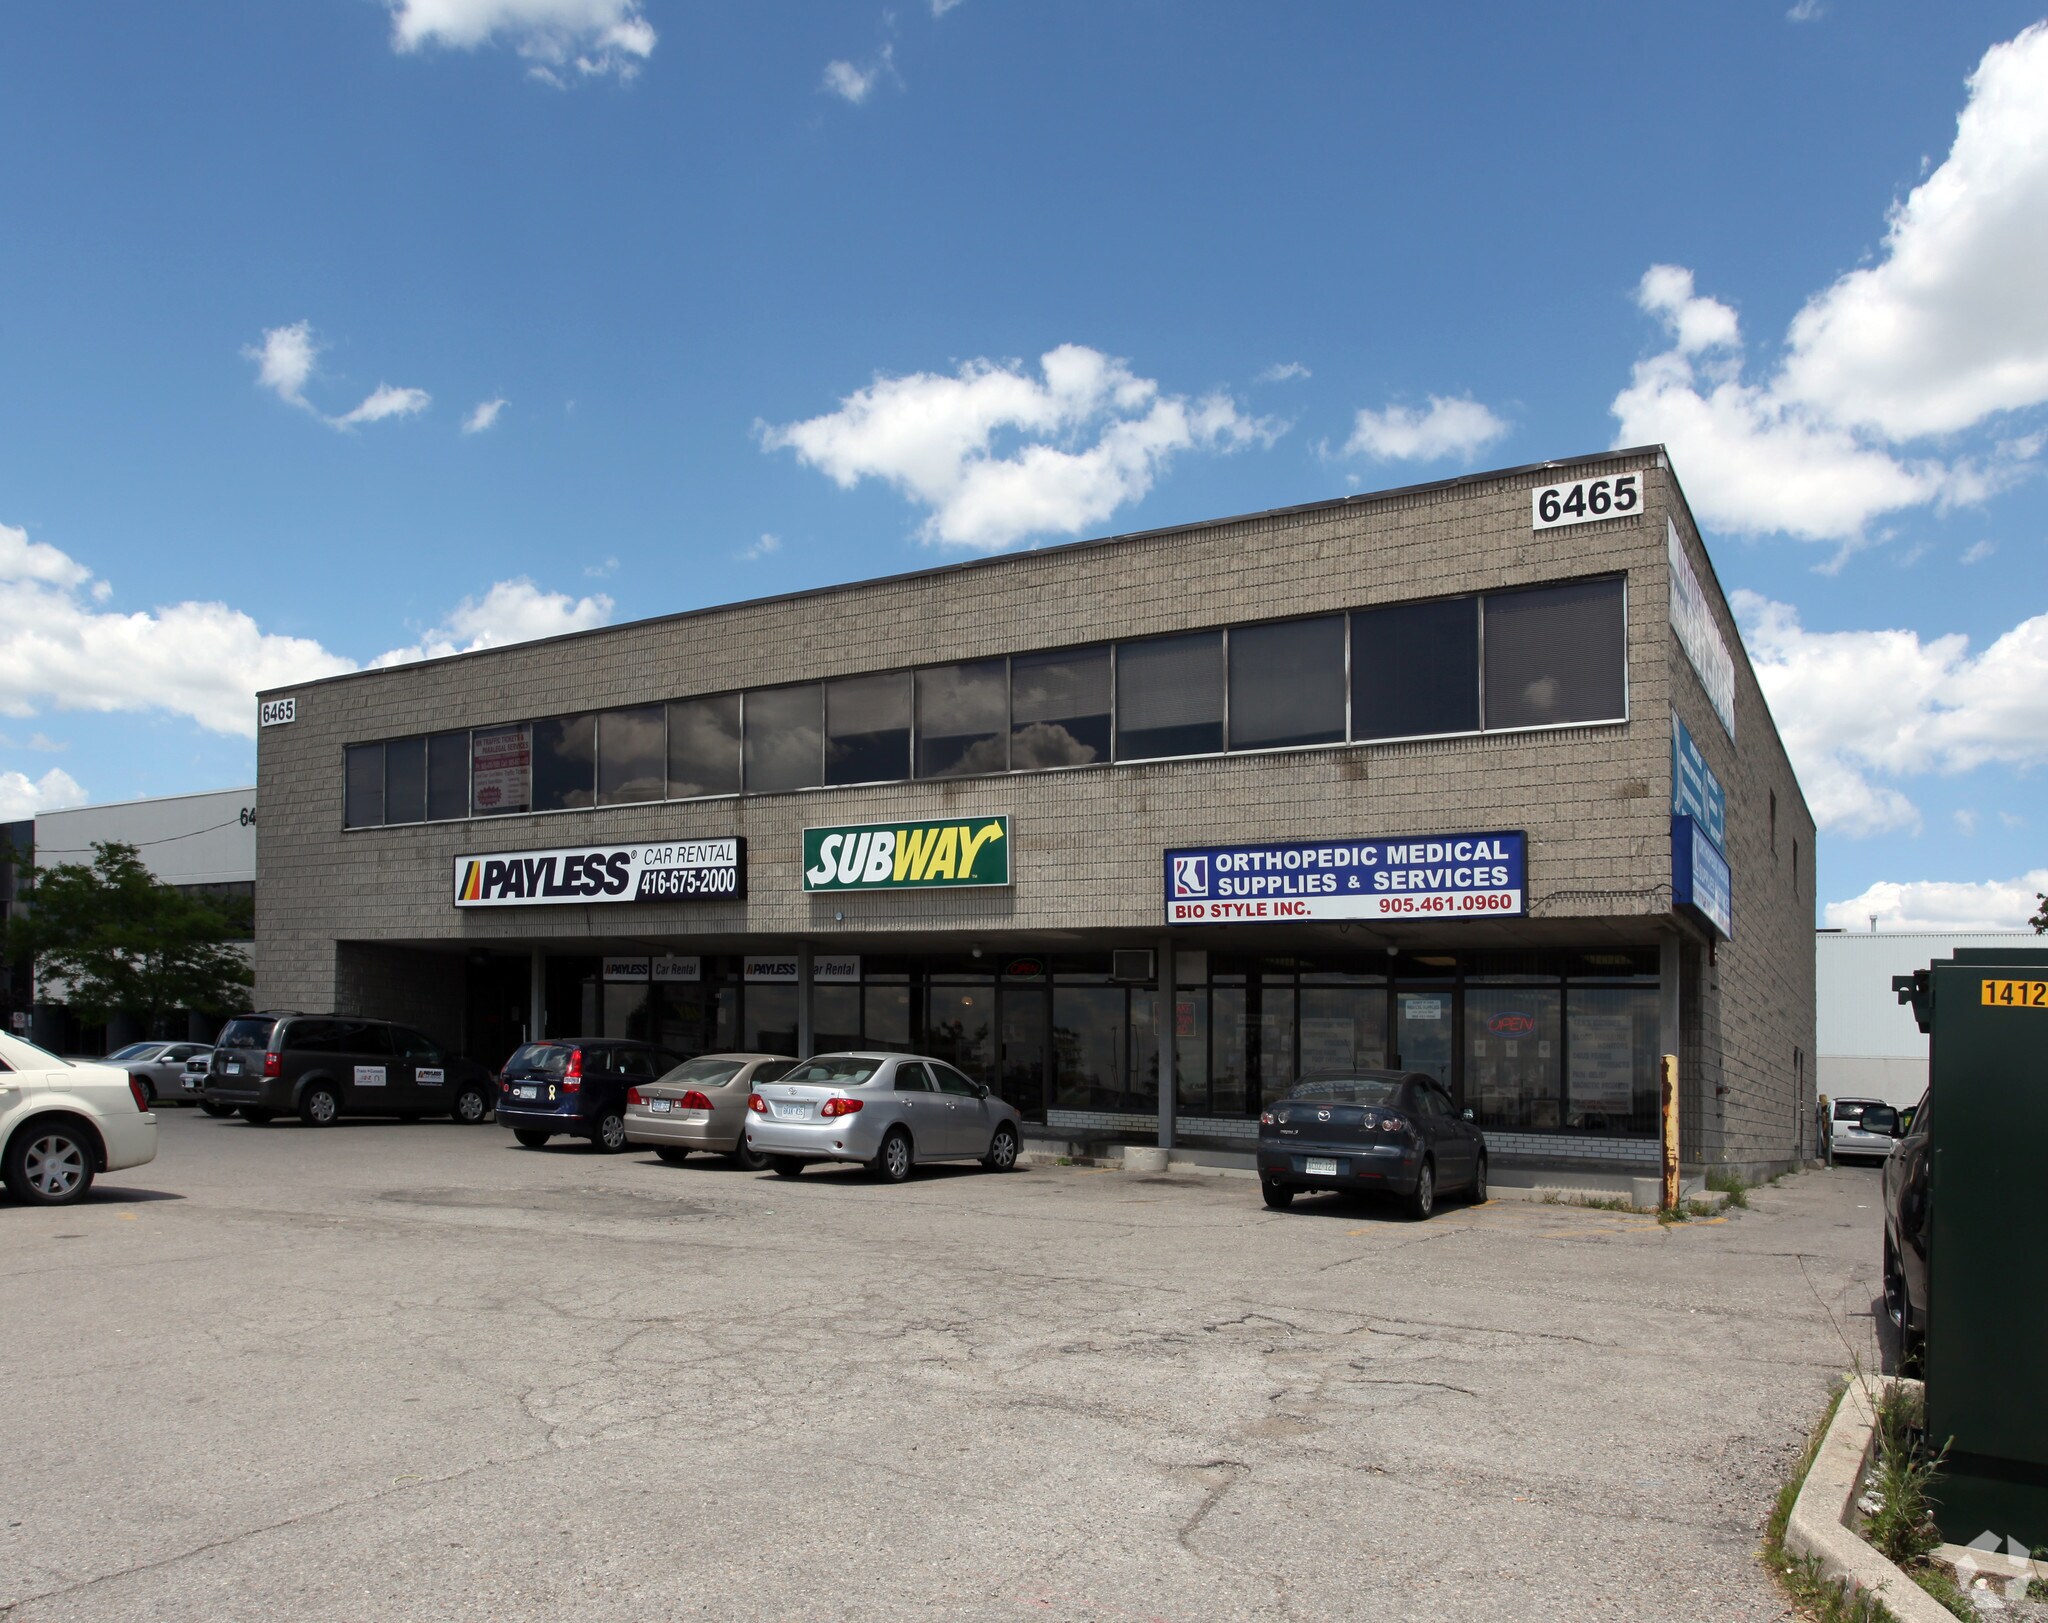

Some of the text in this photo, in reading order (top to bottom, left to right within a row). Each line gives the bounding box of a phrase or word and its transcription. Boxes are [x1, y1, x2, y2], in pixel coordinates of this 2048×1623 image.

[1538, 477, 1638, 523] 6465
[263, 701, 293, 723] 6465
[806, 820, 1004, 889] SUBWAY
[1215, 841, 1508, 872] ORTHOPEDIC MEDICAL
[482, 844, 734, 899] PAYLESS CAR RENTAL
[641, 868, 735, 894] 416-675-2000
[1218, 866, 1509, 896] SUPPLIES & SERVICES
[1175, 894, 1512, 919] BIO STYLE INC. 905.461.0960
[611, 963, 697, 975] PAYLESS Car Rental
[753, 962, 855, 976] PAYLESS ar Rental
[1488, 1016, 1535, 1031] OPEN
